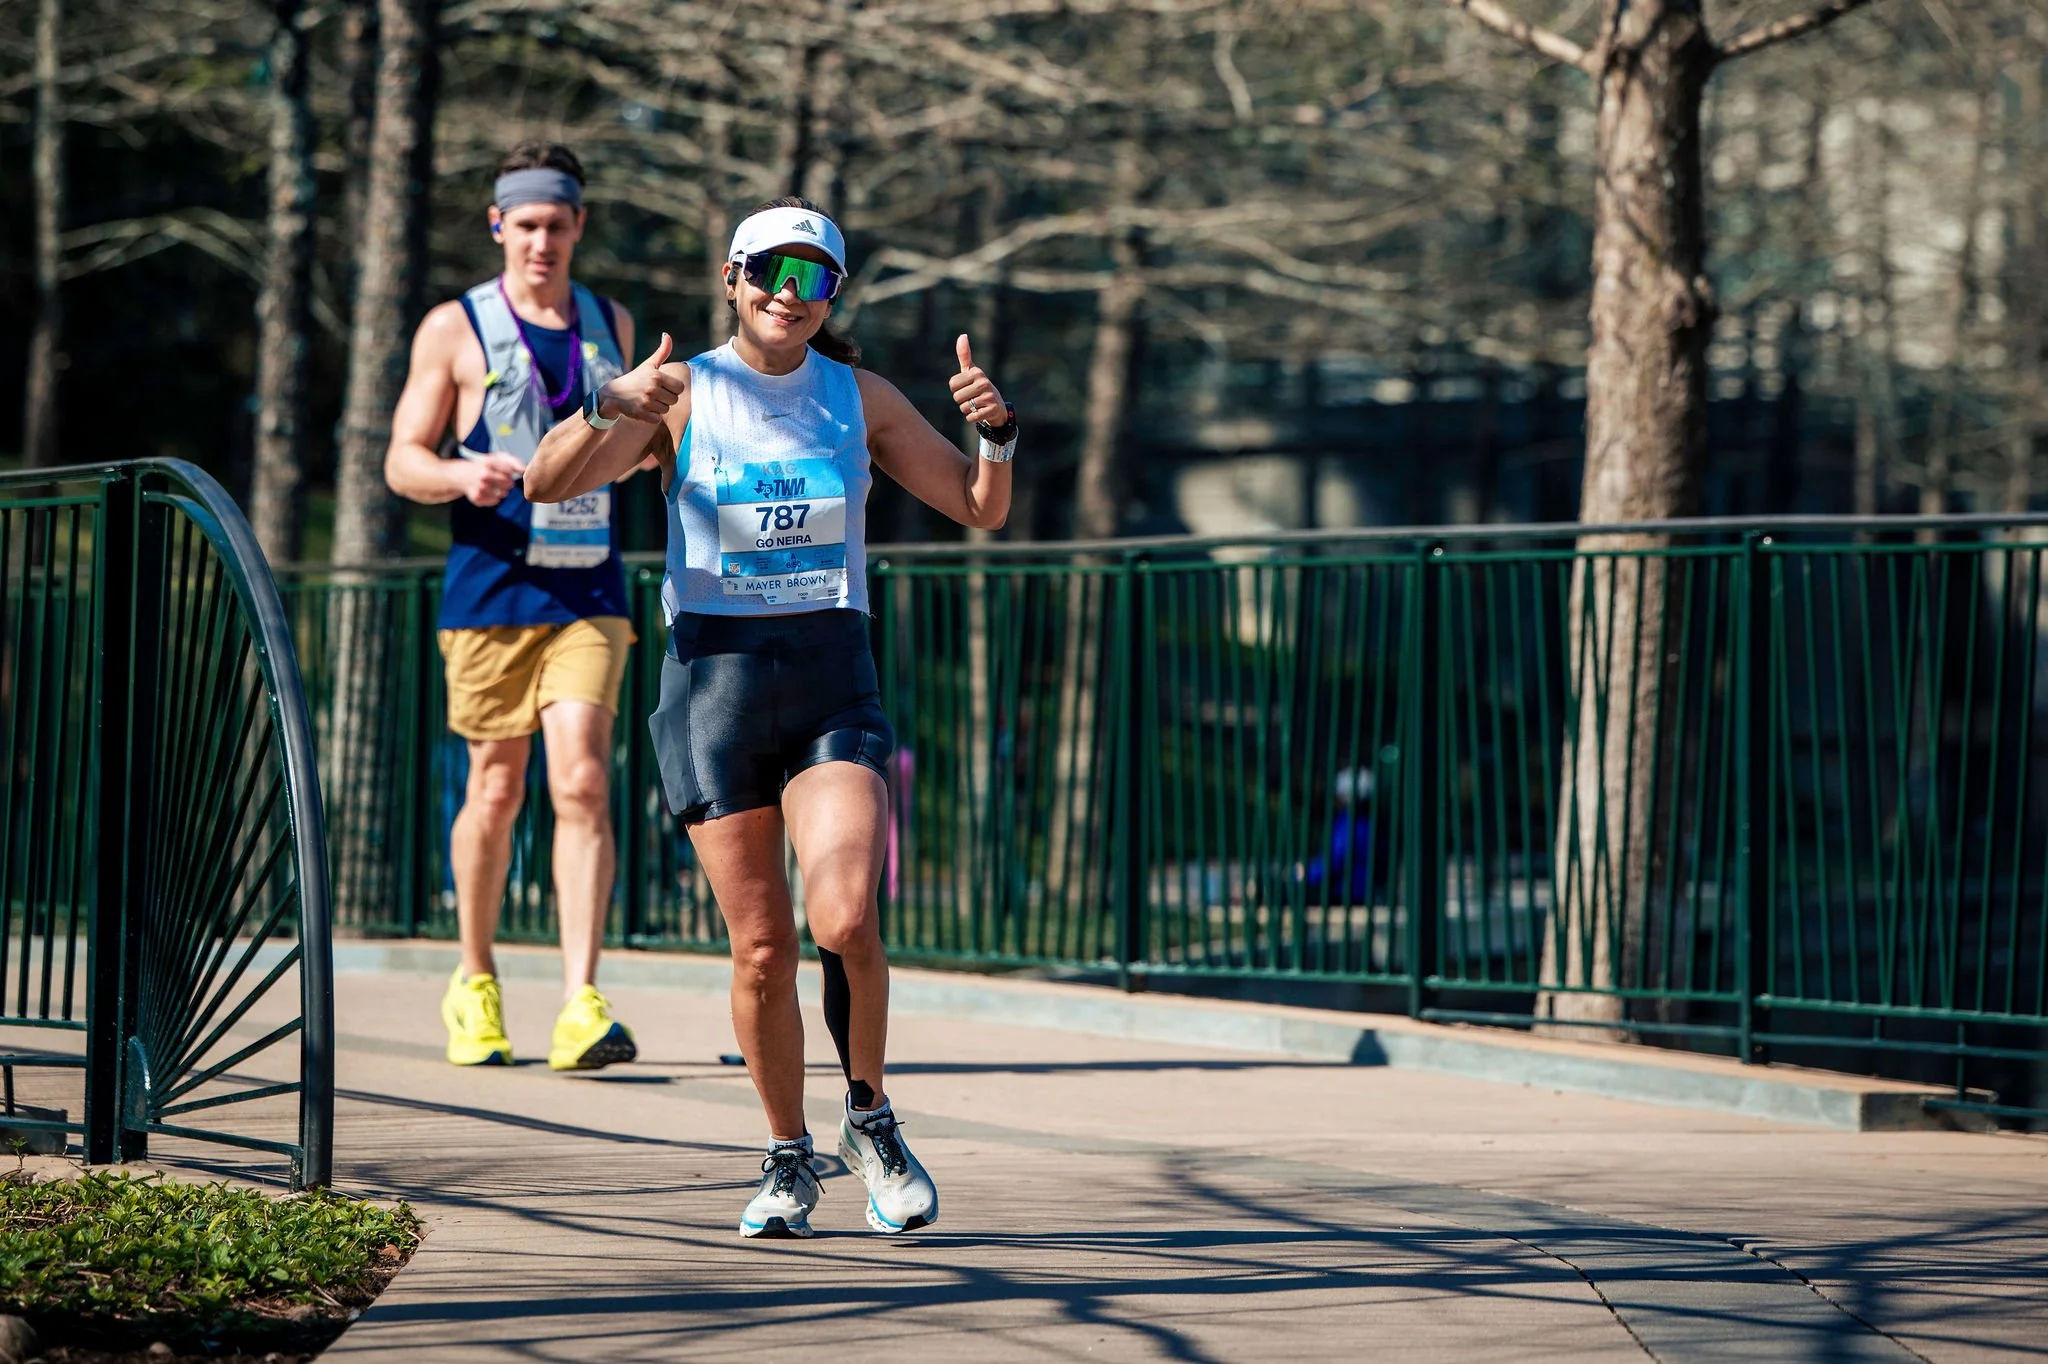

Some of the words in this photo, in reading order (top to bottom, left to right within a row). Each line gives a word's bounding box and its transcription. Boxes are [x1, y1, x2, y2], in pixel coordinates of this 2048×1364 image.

[762, 463, 798, 476] KAG
[773, 477, 806, 497] TWM
[756, 504, 810, 532] 787
[756, 538, 774, 549] GO
[777, 534, 812, 547] NEIRA
[745, 579, 782, 592] MAYER
[787, 574, 827, 588] BROWN
